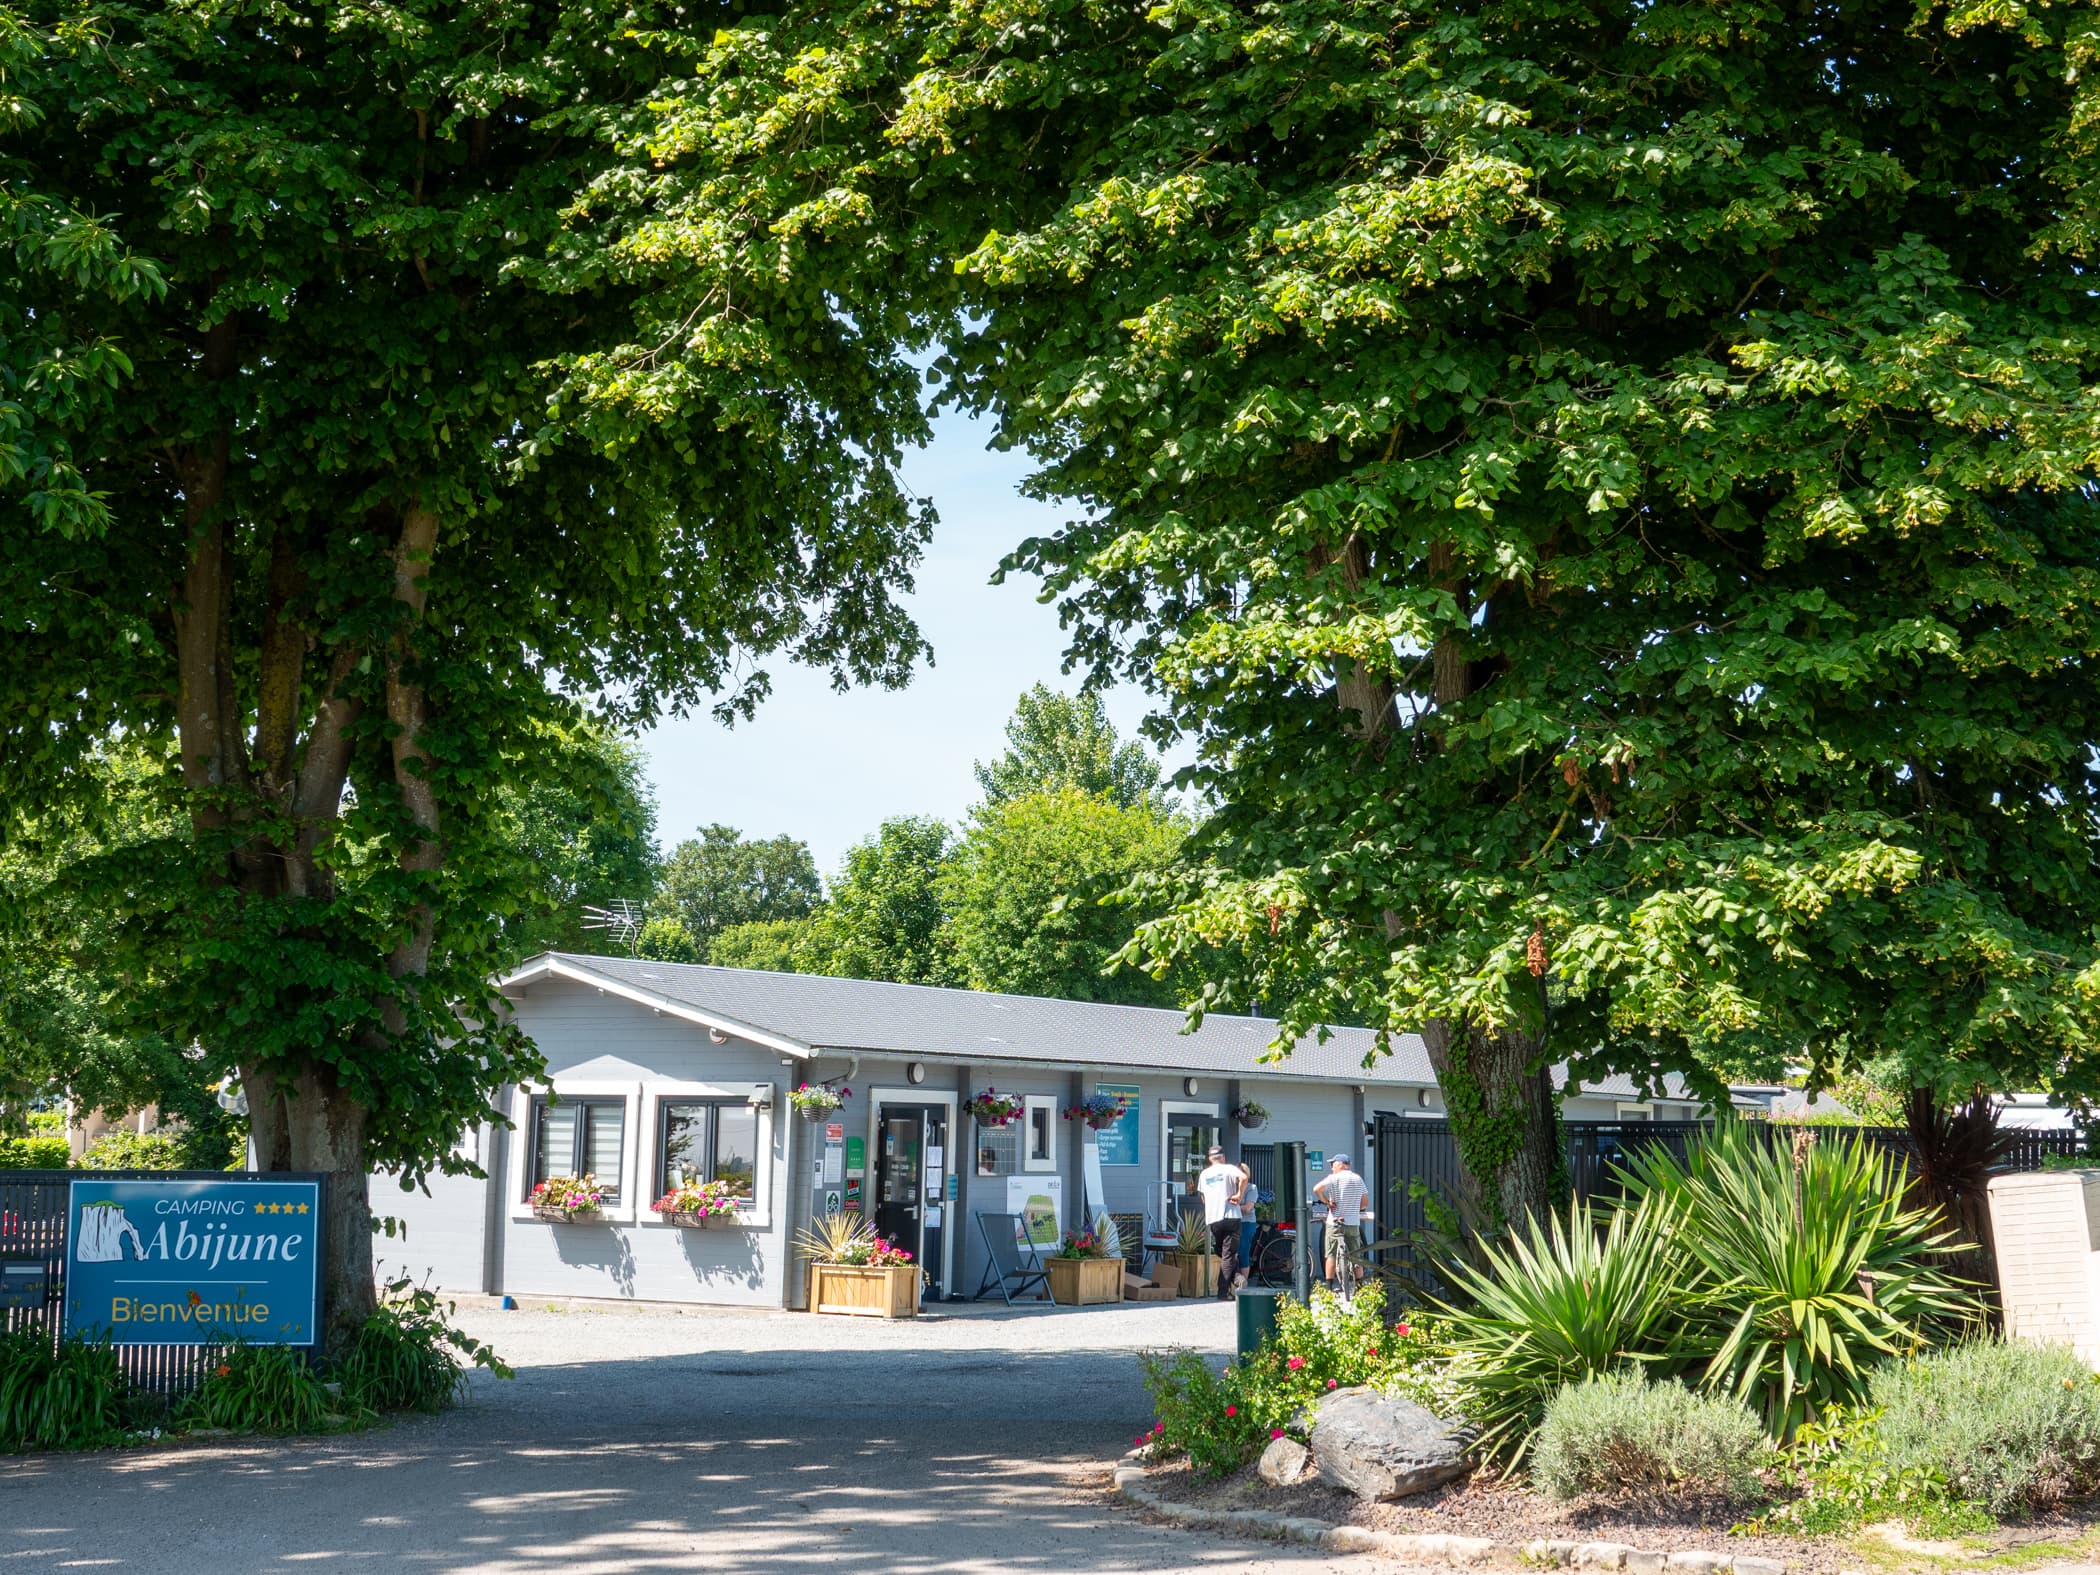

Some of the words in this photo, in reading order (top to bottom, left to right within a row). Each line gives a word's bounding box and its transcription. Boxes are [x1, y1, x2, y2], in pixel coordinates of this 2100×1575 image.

[154, 1200, 246, 1215] CAMPING
[145, 1219, 303, 1271] Abijune
[111, 1297, 270, 1323] Bienvenue
